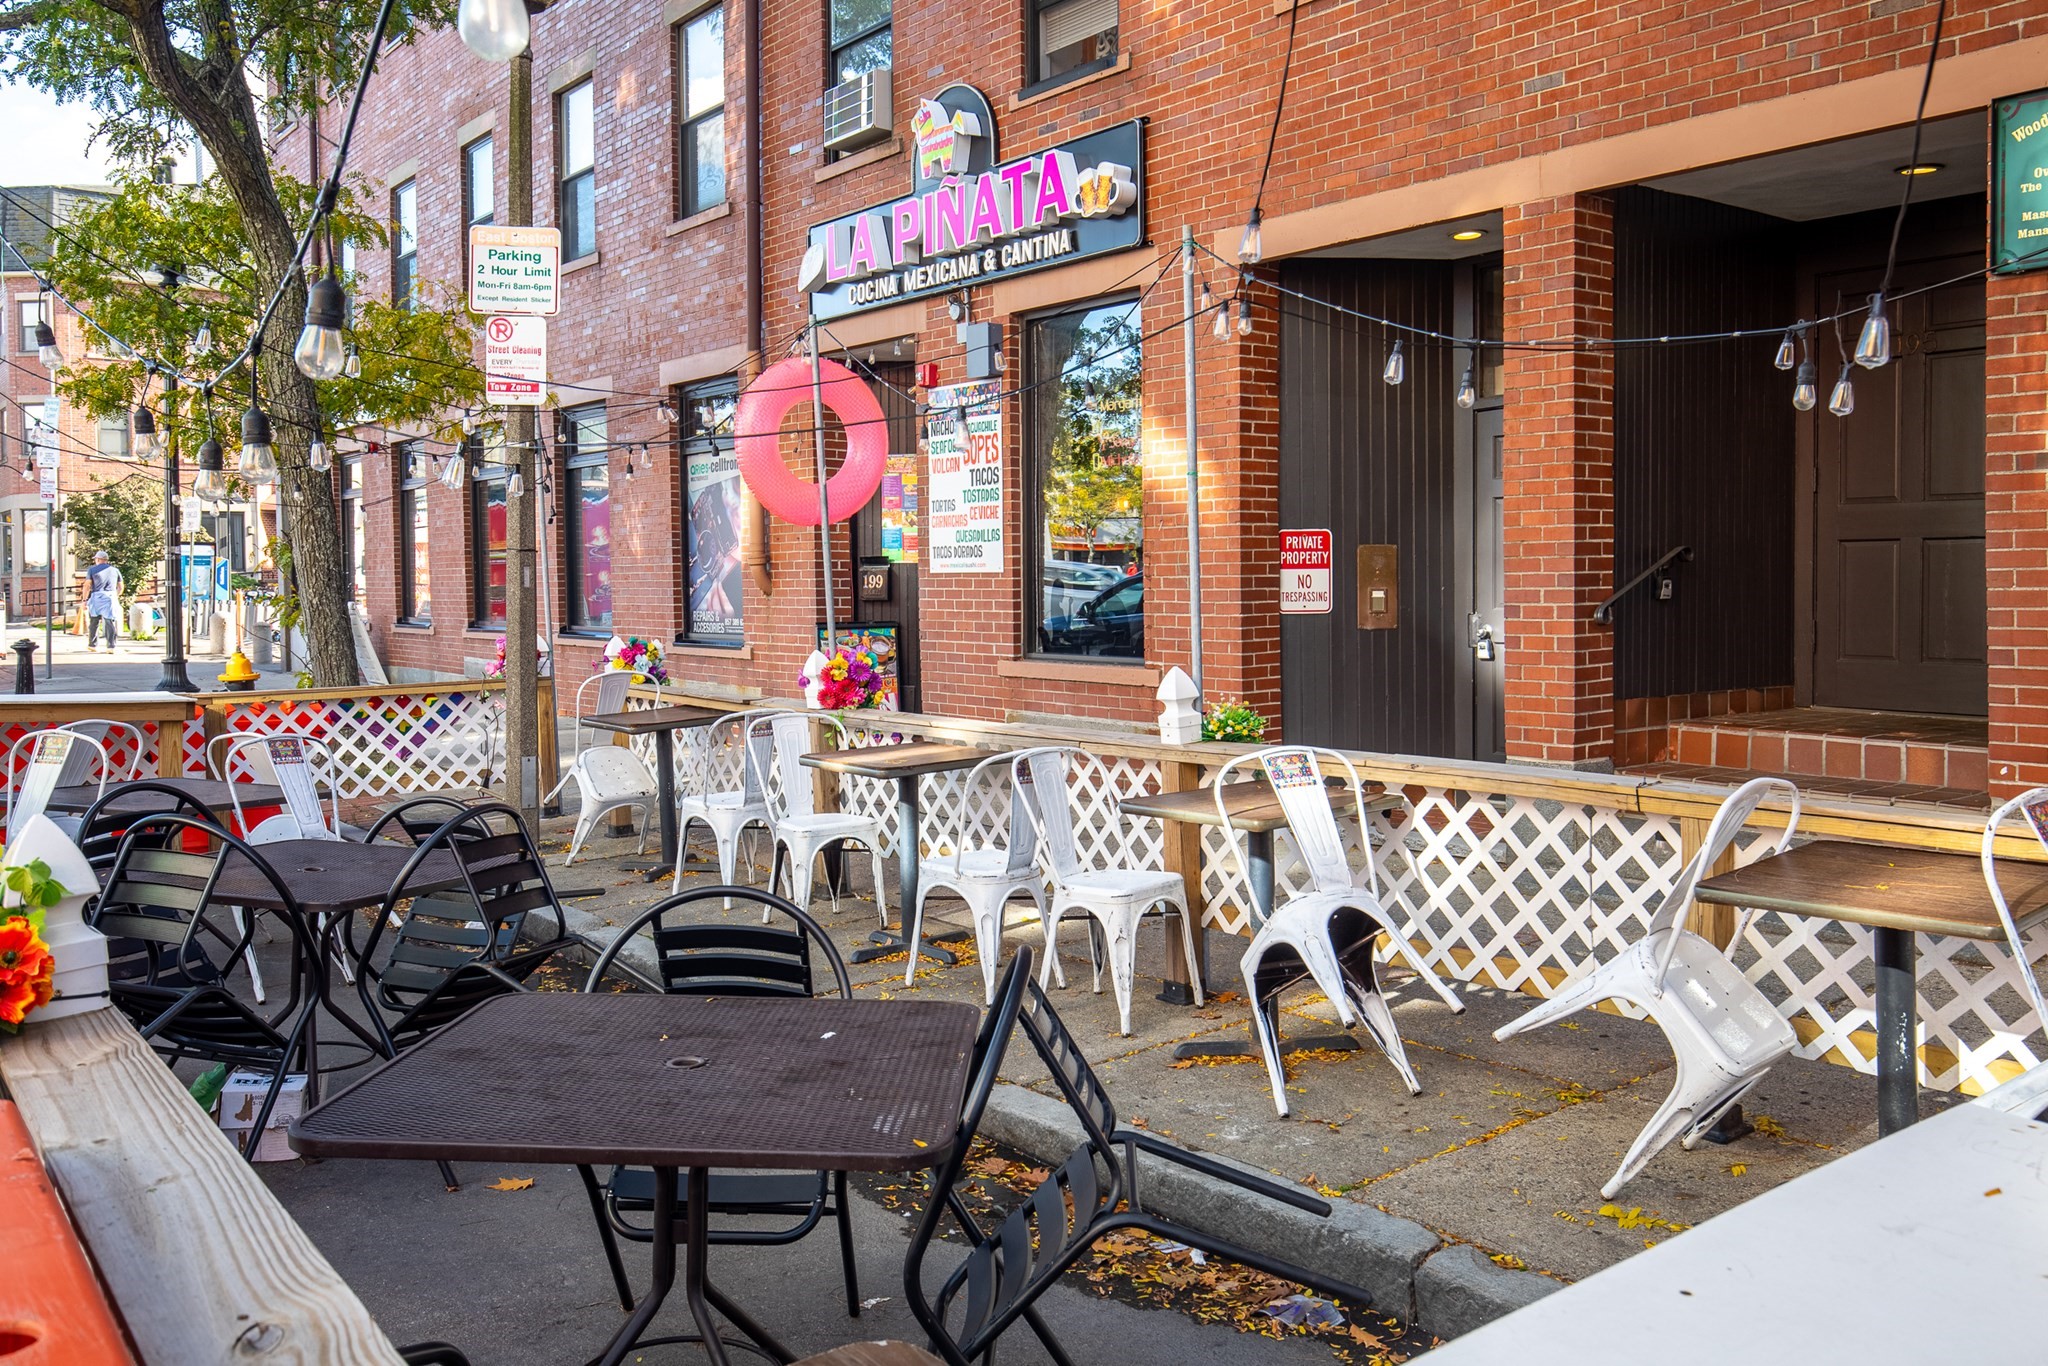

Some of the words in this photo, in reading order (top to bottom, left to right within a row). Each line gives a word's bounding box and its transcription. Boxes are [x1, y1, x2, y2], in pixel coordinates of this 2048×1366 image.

[2020, 183, 2042, 193] The
[826, 213, 878, 283] LA
[892, 148, 1071, 266] PIÑATA
[477, 231, 505, 243] East
[488, 249, 542, 264] Parking
[477, 264, 485, 274] 2
[491, 265, 517, 276] Hour
[524, 266, 551, 277] Limit
[848, 274, 898, 305] COCINA
[904, 253, 979, 292] MEXICANA
[983, 249, 997, 272] &
[1001, 229, 1072, 267] CANTINA
[477, 280, 511, 290] Mon-Fri
[513, 283, 552, 292] 8am-6pm
[477, 294, 499, 302] Except
[488, 344, 509, 354] Street
[512, 346, 542, 356] Cleaning
[490, 383, 507, 391] Tow
[510, 383, 532, 392] Zone
[932, 457, 960, 474] VOLCAN
[969, 466, 999, 487] TACOS
[962, 488, 999, 503] TOSTADAS
[931, 499, 956, 513] TORTAS
[969, 505, 999, 520] CEVICHE
[955, 529, 1000, 543] QUESADILLAS
[1285, 536, 1323, 549] PRIVATE
[932, 546, 952, 559] TACOS
[953, 545, 983, 558] DORADOS
[1280, 551, 1329, 564] PROPERTY
[863, 575, 884, 589] 199
[1297, 574, 1312, 589] NO
[1281, 592, 1328, 602] TRESPASSING
[692, 610, 715, 621] REPAIRS
